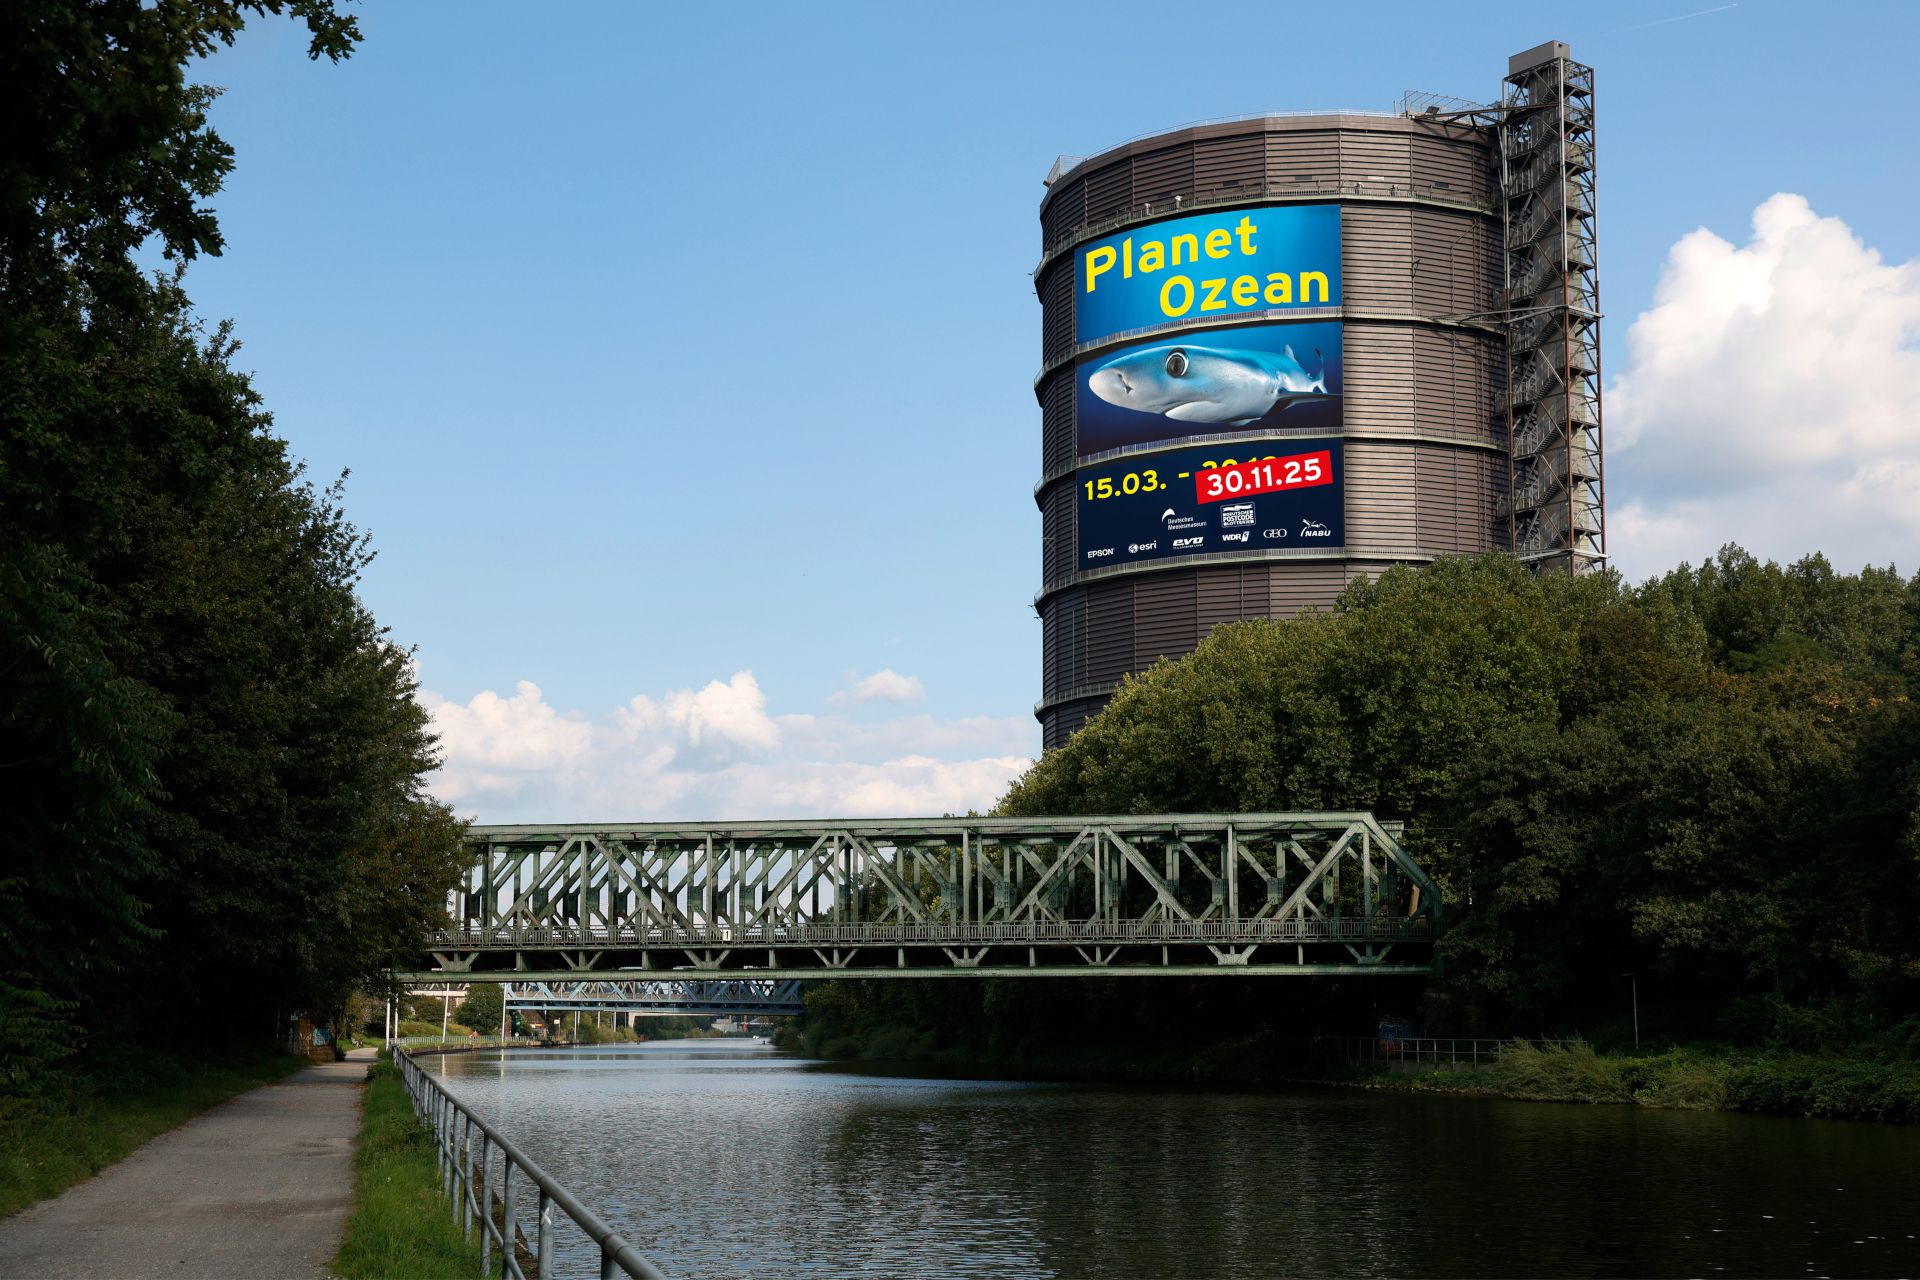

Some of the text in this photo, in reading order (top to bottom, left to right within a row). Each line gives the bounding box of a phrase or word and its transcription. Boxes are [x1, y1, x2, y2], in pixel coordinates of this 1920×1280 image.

[1085, 215, 1258, 294] Planet
[1160, 270, 1329, 318] Ozean
[1084, 469, 1167, 500] 15.03.
[1207, 457, 1322, 496] 30.11.25
[1223, 513, 1254, 522] POSTCODE
[1222, 533, 1242, 542] WDR
[1263, 528, 1287, 538] GEO
[1139, 540, 1157, 551] esri
[1172, 536, 1204, 547] evo
[1087, 548, 1114, 558] EPSON
